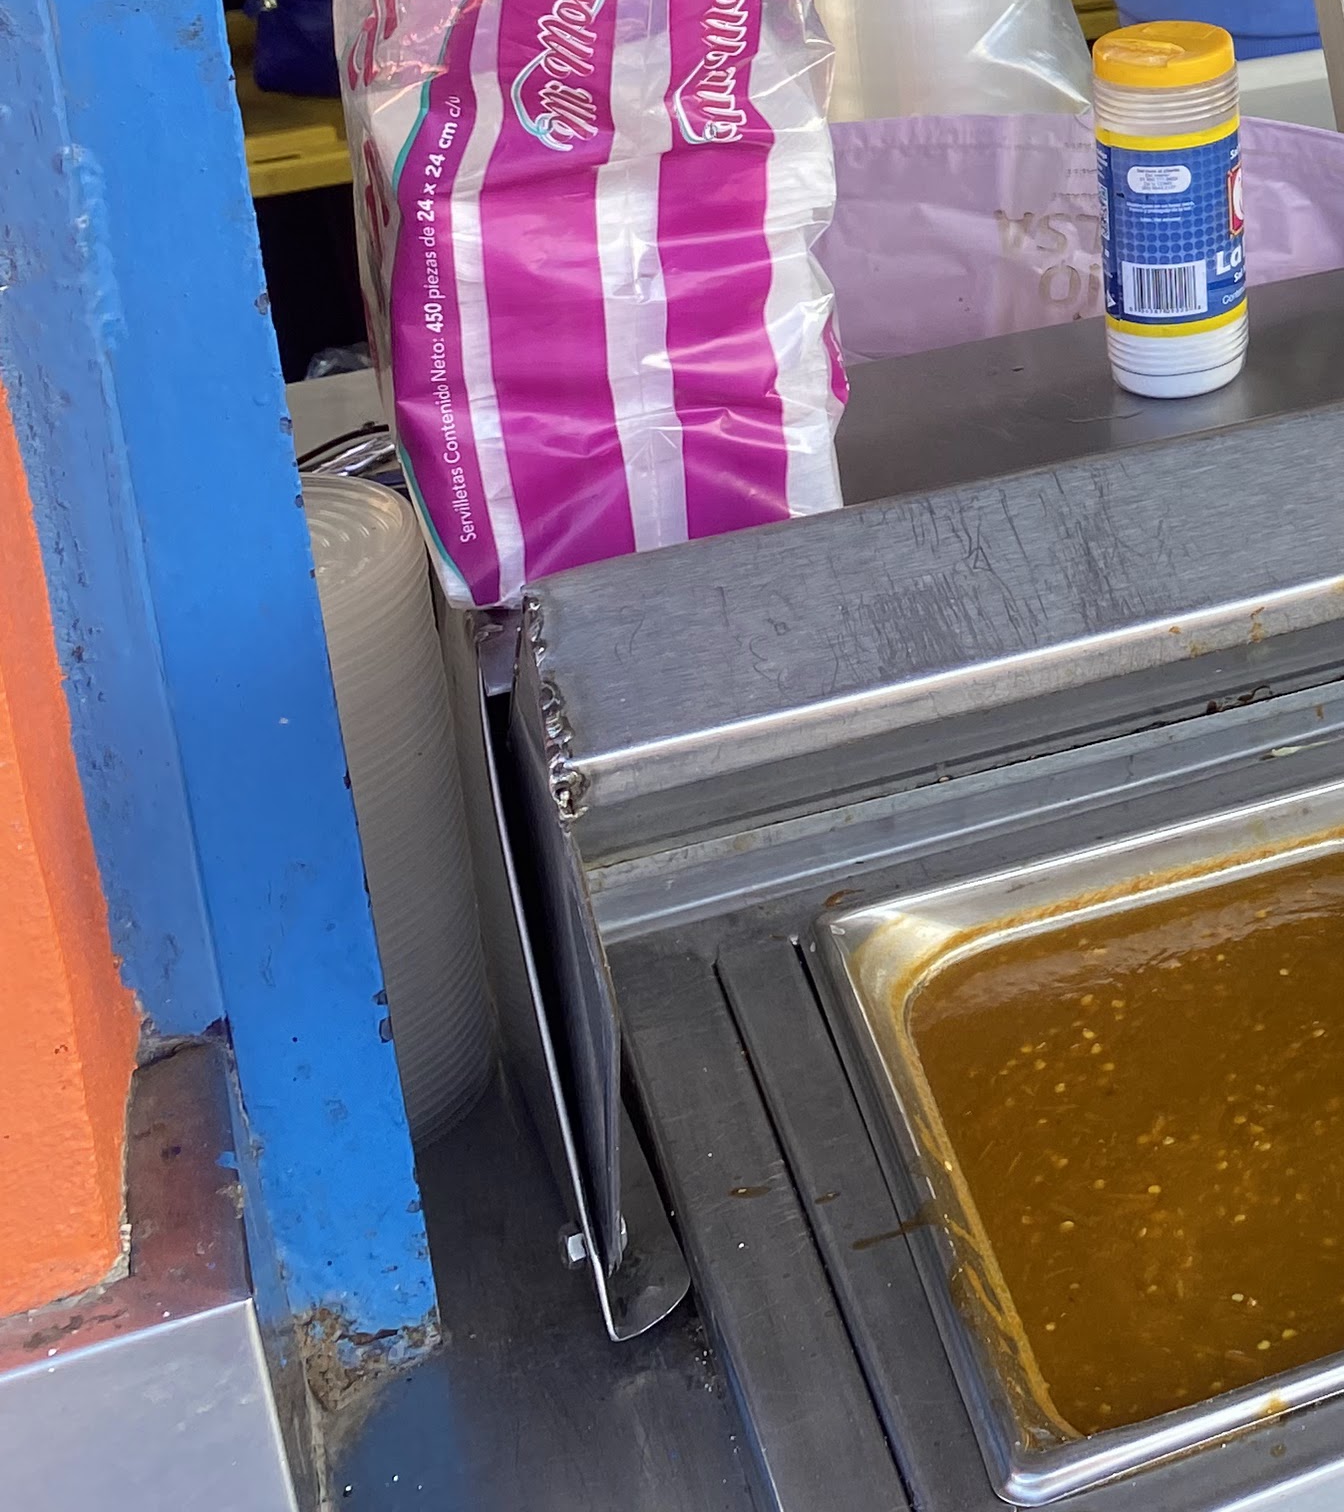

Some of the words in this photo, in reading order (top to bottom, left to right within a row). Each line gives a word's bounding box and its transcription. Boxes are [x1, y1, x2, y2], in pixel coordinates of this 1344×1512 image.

[444, 95, 463, 119] c/u
[438, 120, 459, 150] cm
[425, 152, 447, 179] 24
[423, 182, 436, 196] x
[417, 197, 436, 223] 24
[418, 226, 436, 247] de
[423, 250, 447, 300] piezas
[423, 301, 445, 334] 450
[430, 337, 447, 383] Neto:
[435, 383, 461, 465] Contenido
[451, 467, 477, 544] Servilletas
